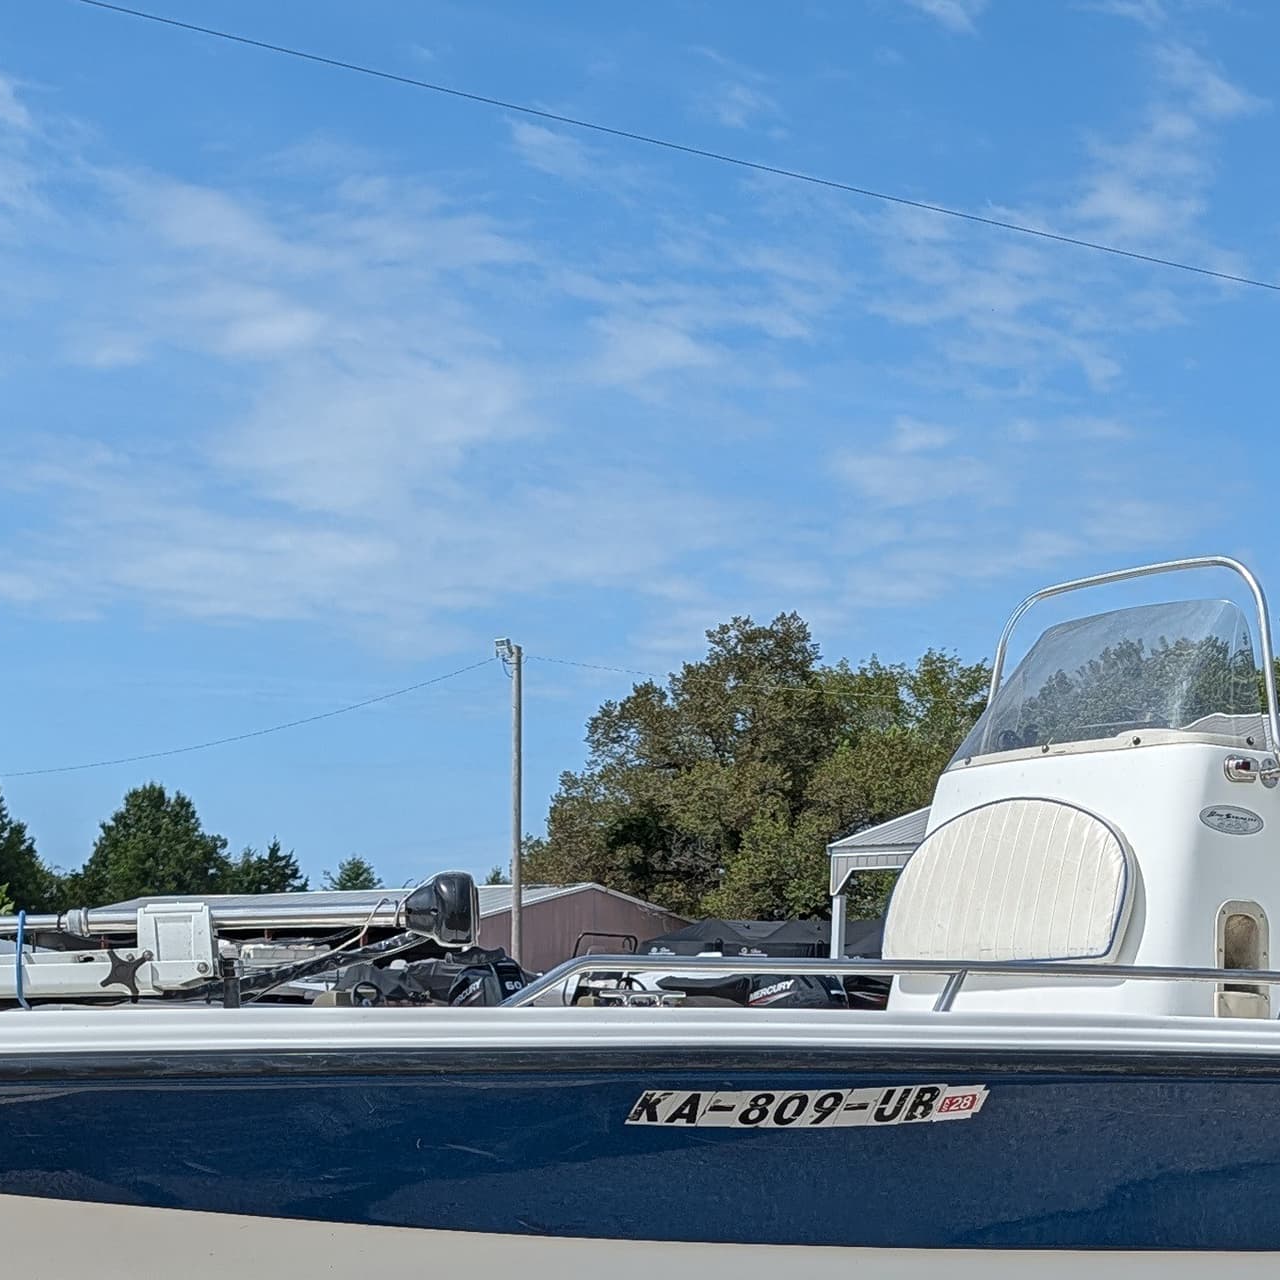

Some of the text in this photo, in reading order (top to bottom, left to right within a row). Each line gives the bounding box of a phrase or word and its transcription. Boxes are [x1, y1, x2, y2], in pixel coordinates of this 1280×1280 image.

[505, 980, 522, 990] 60
[748, 979, 795, 1001] MERCURY
[950, 1095, 973, 1110] 28
